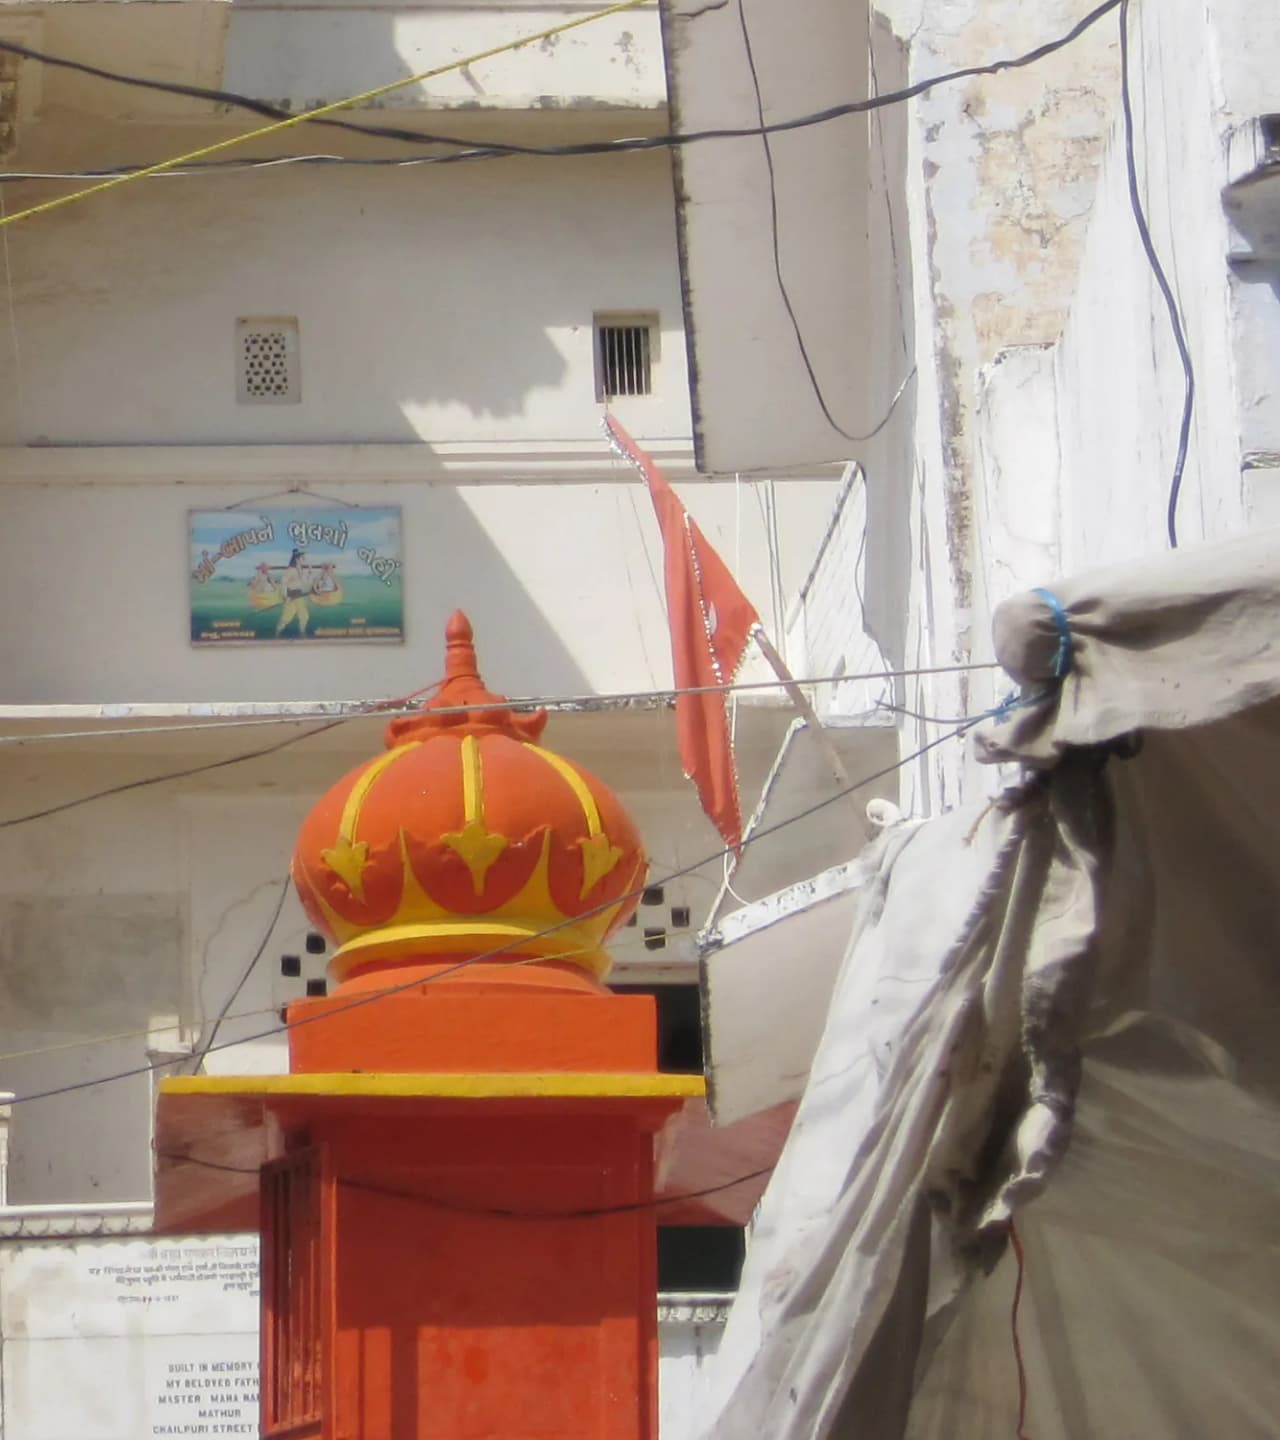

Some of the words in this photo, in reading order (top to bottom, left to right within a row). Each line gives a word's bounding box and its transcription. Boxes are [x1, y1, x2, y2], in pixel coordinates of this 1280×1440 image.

[168, 1362, 195, 1373] BUILT
[199, 1362, 208, 1372] IN
[211, 1361, 253, 1372] MEMORY
[166, 1379, 181, 1388] MY
[184, 1378, 231, 1388] BELOVED
[234, 1377, 260, 1387] FATH
[158, 1394, 201, 1404] MASTER
[198, 1408, 242, 1418] MATHUR
[212, 1423, 253, 1434] STREET
